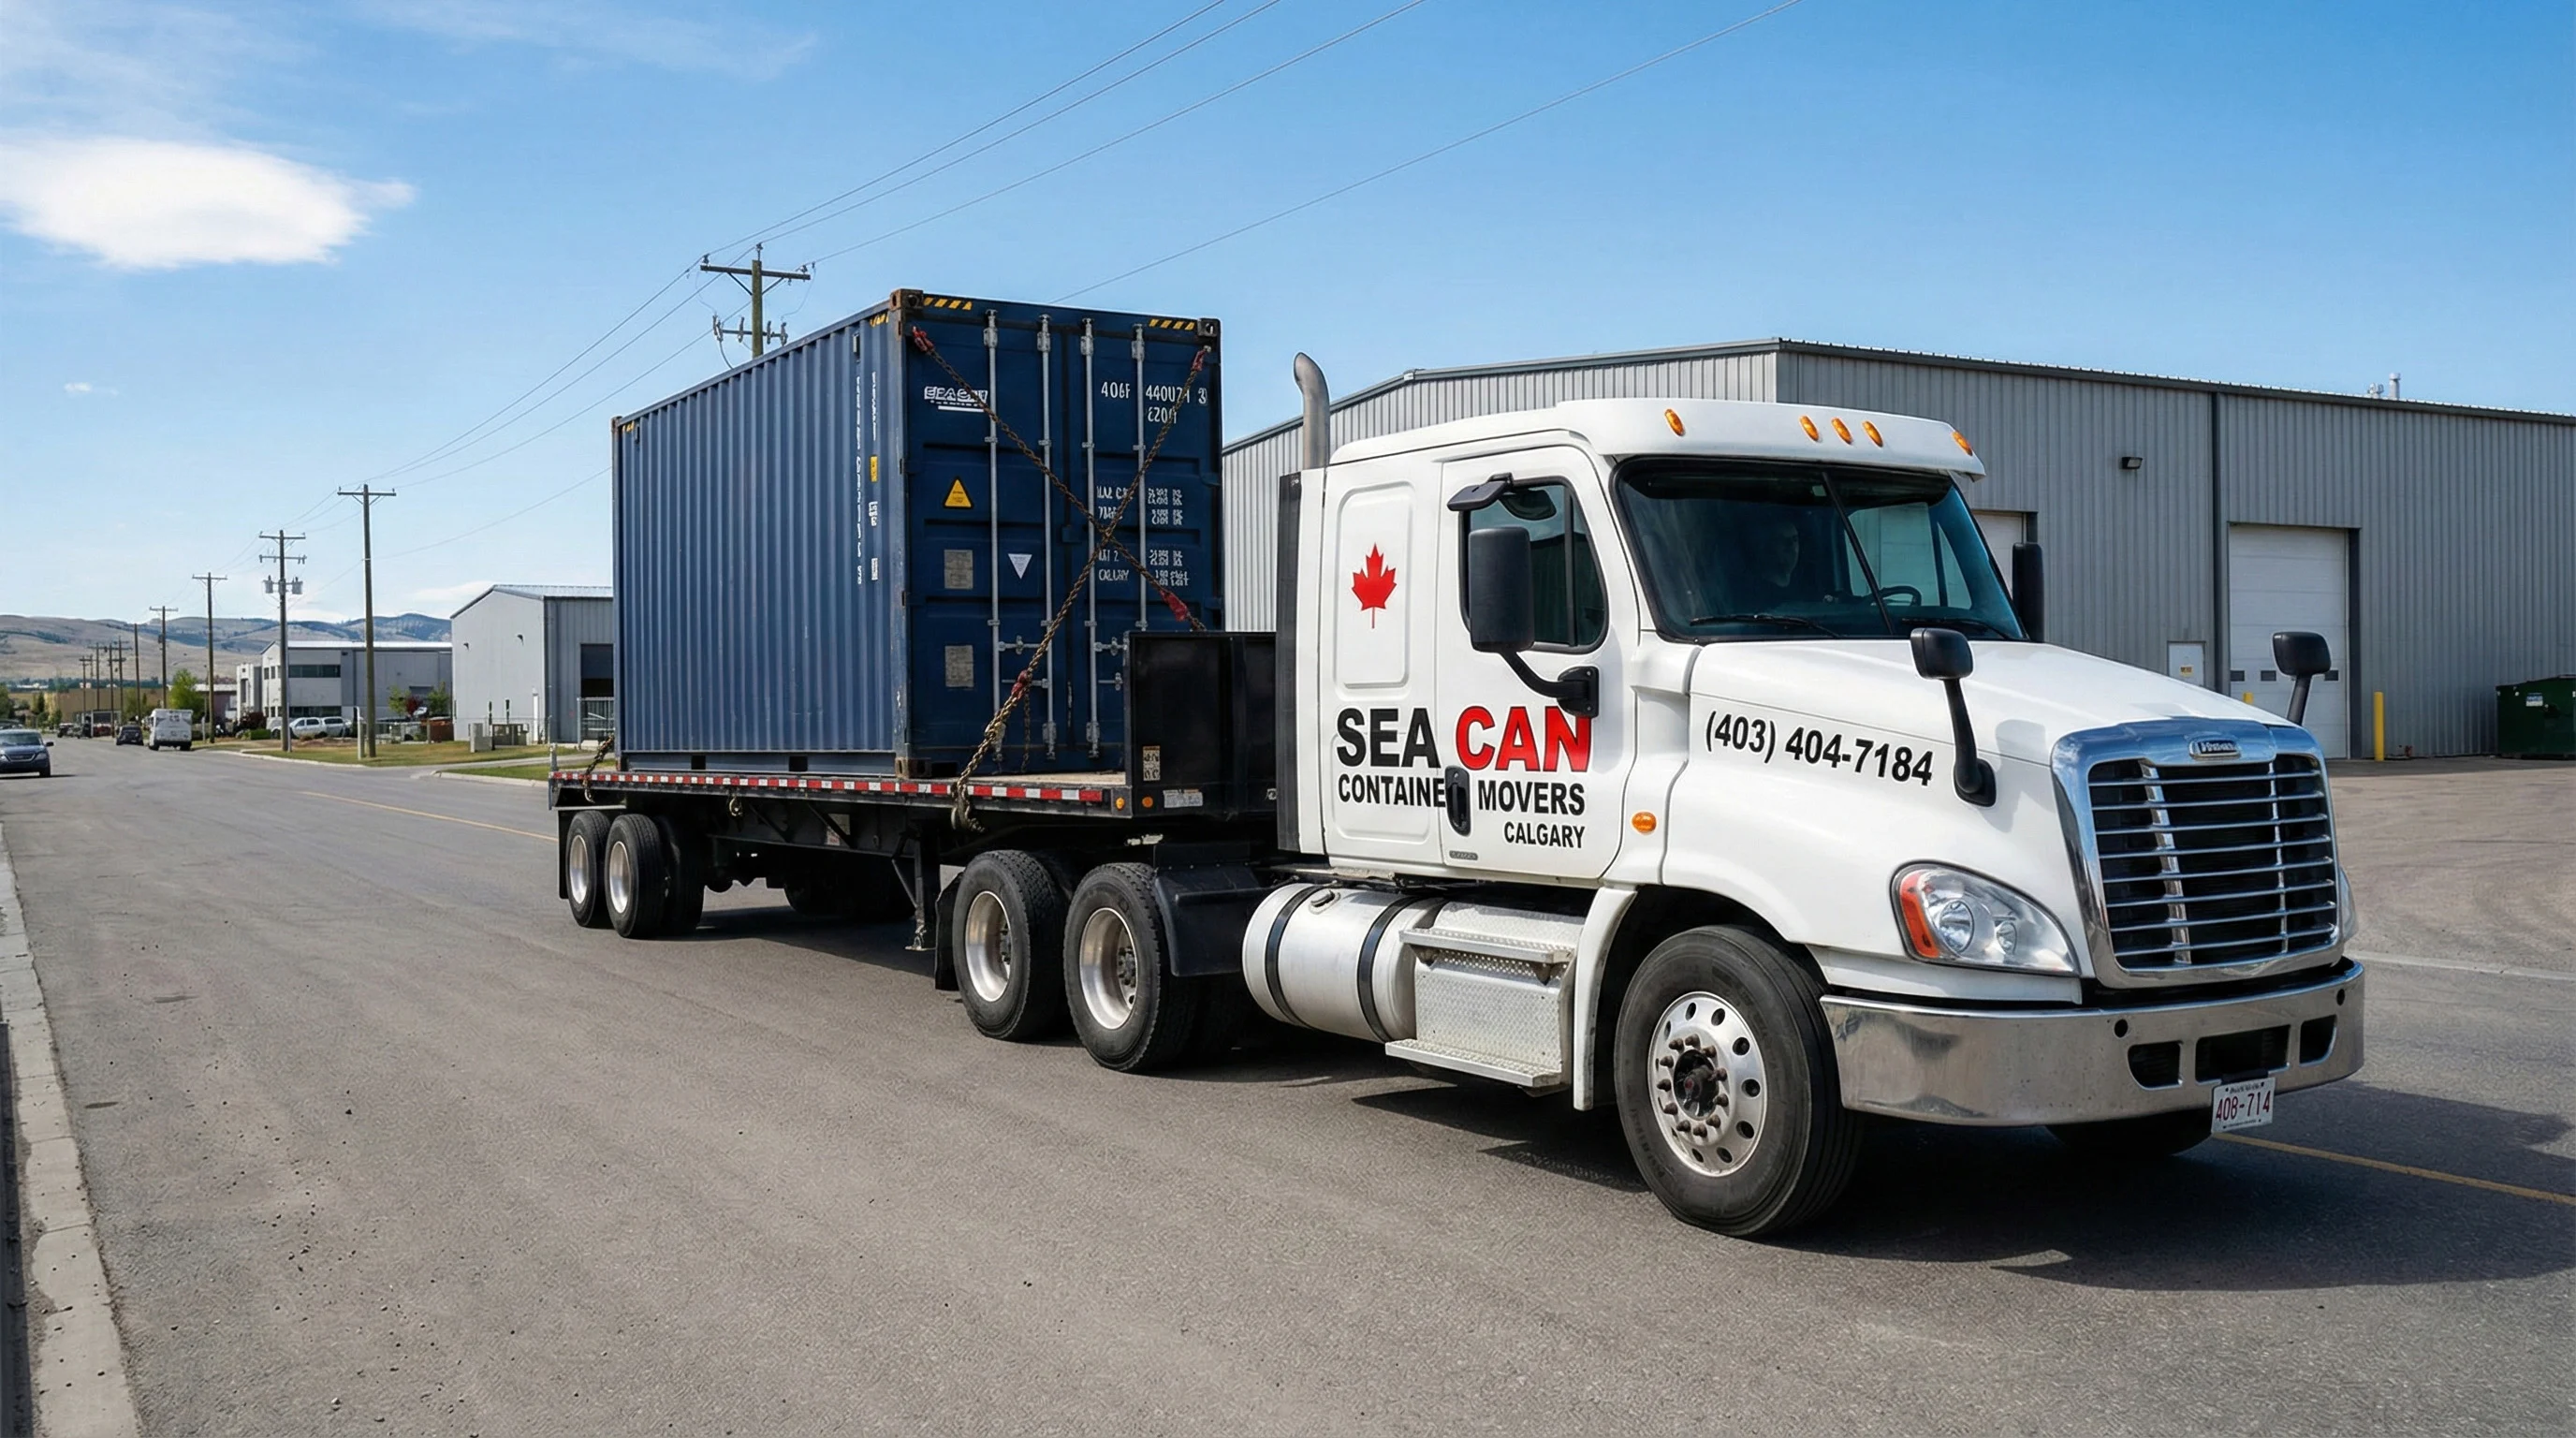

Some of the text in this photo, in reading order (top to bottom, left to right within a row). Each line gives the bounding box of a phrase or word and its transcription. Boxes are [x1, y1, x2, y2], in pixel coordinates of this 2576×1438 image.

[1336, 705, 1590, 772] SEA CAN
[1705, 711, 1933, 786] (403) 404-7184
[1338, 773, 1585, 816] CONTAINE MOVERS
[1503, 821, 1586, 849] CALGARY
[2216, 1090, 2271, 1121] 408-714
